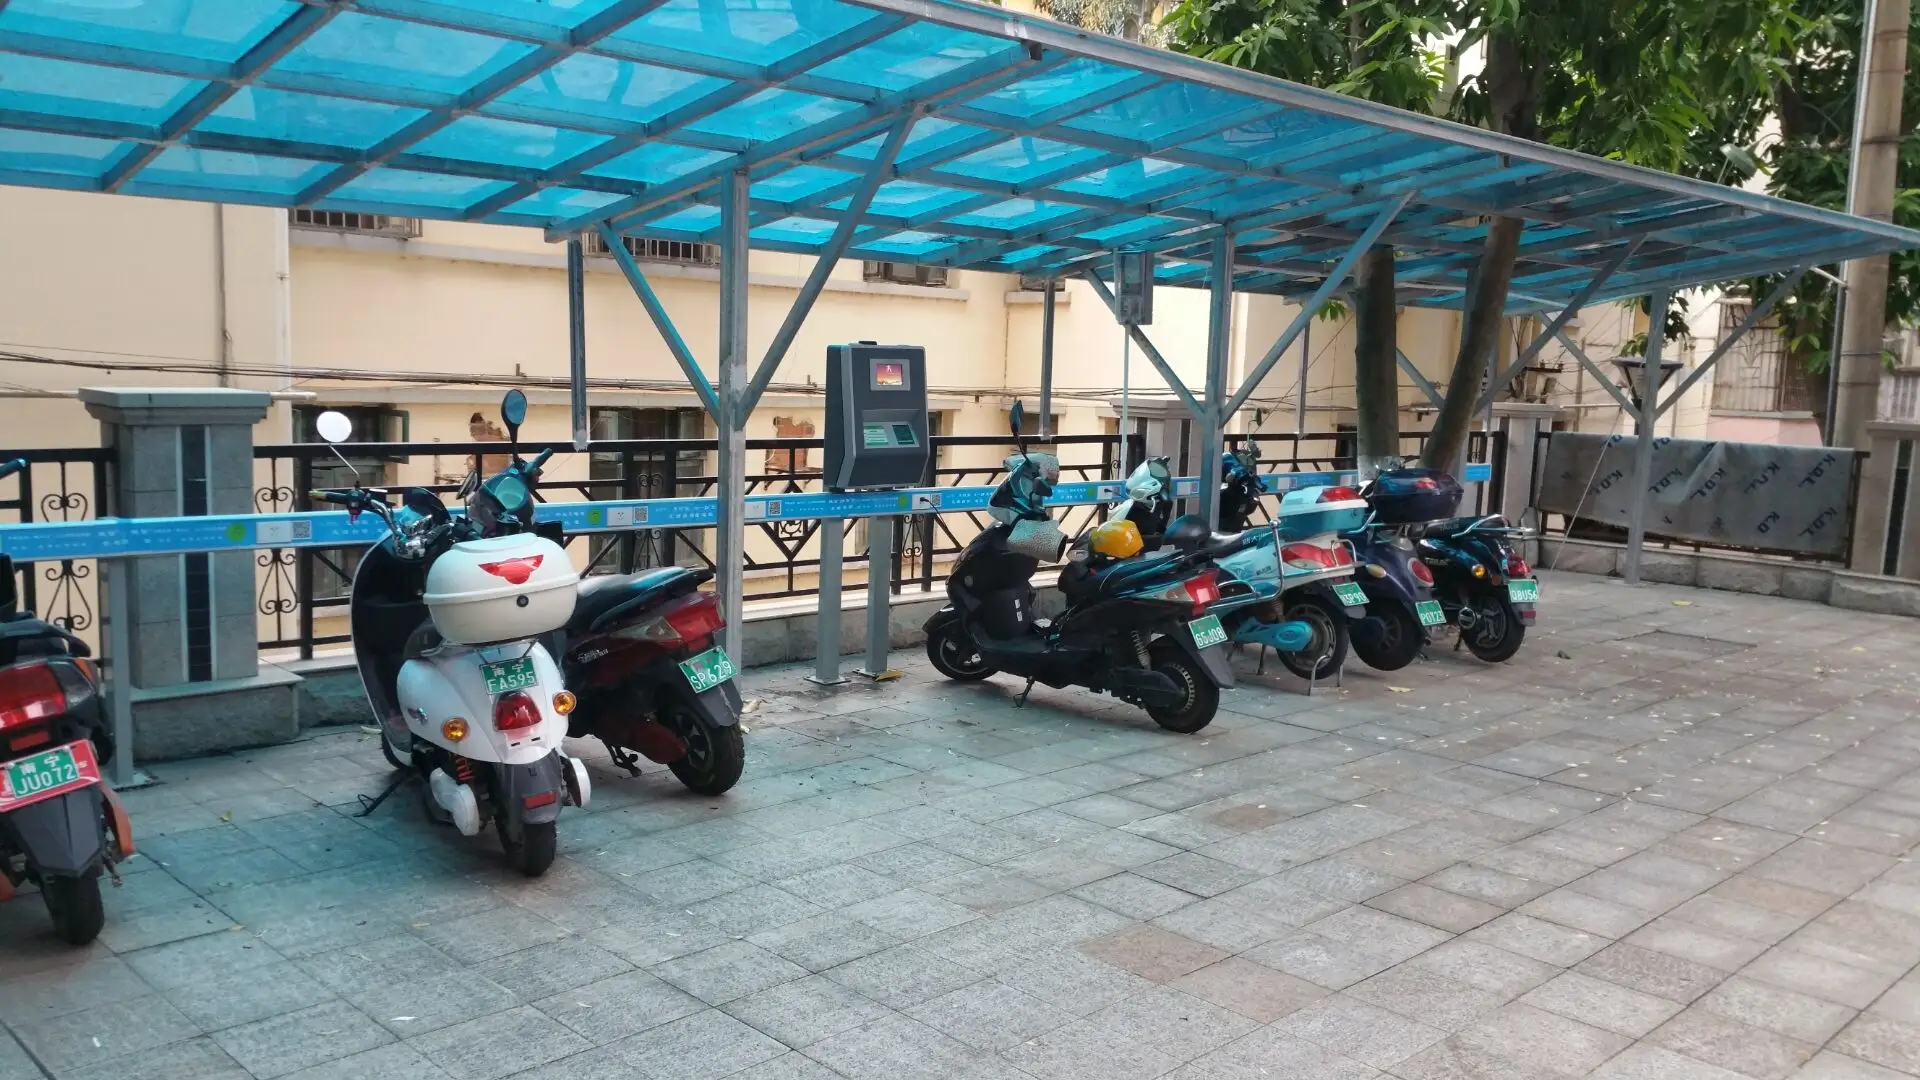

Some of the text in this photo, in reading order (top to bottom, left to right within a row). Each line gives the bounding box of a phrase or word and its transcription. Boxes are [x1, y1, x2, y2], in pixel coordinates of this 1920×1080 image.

[487, 671, 535, 692] FA595
[690, 661, 732, 690] SP629
[17, 763, 76, 795] JU072
